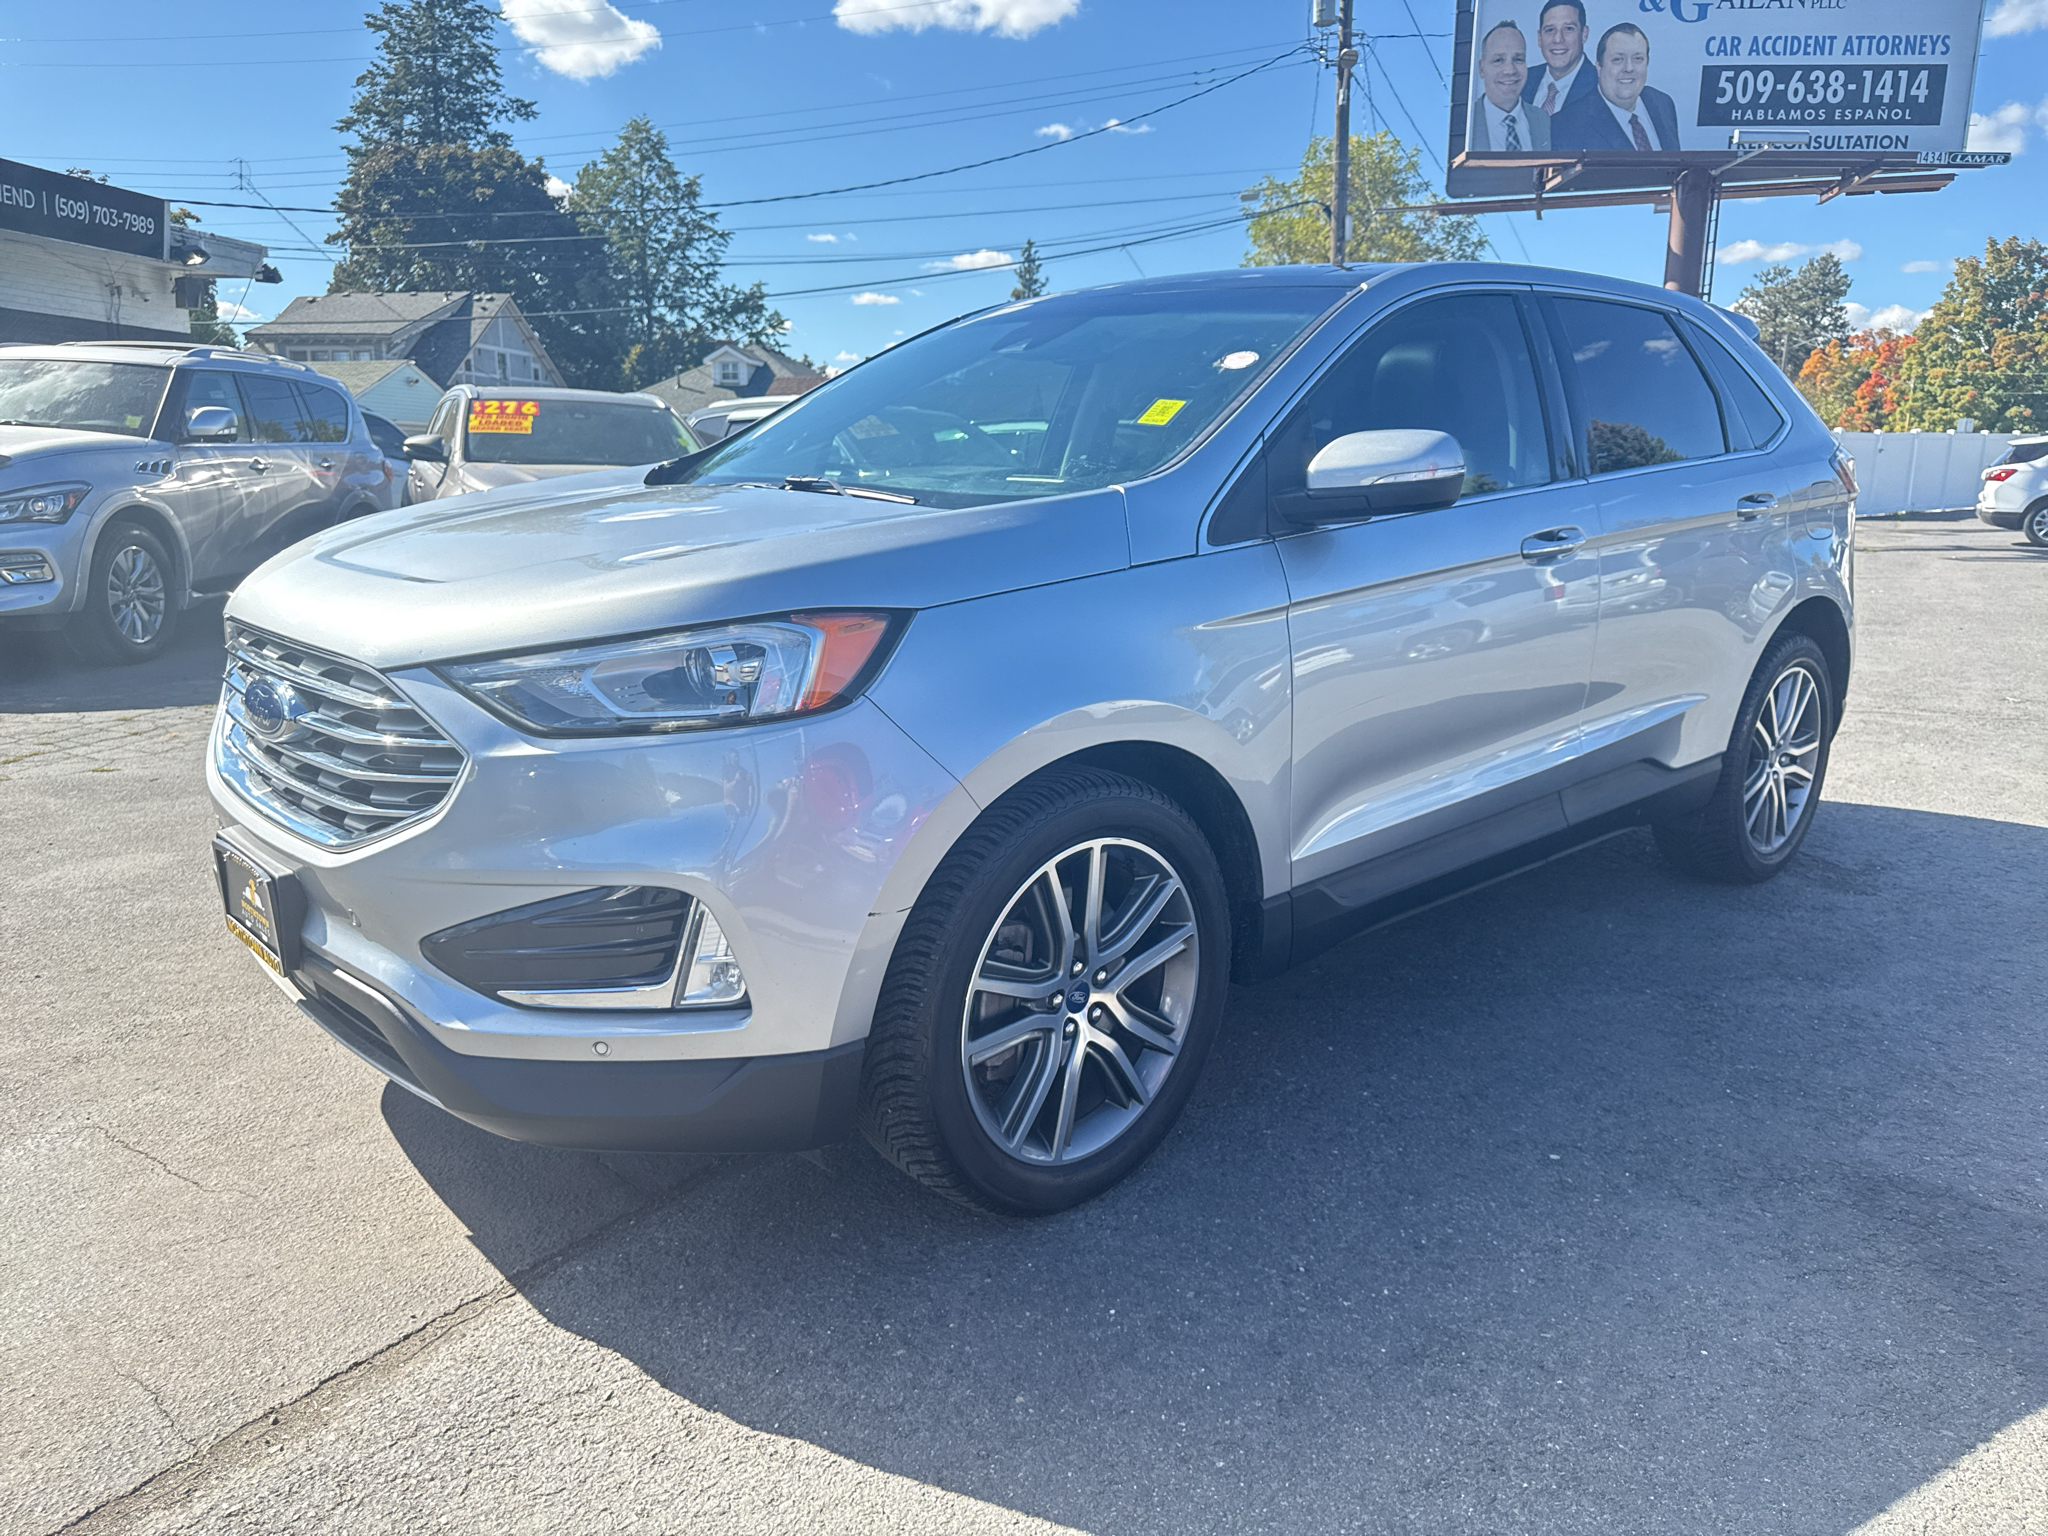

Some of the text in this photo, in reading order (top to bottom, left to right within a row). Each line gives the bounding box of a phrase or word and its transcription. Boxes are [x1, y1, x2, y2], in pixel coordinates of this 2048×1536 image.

[1705, 34, 1951, 57] CAR ACCIDENT ATTORNEYS
[1715, 69, 1930, 105] 509-638-1414
[1731, 106, 1912, 121] HABLAMOS ESPAÑOL
[1955, 154, 2006, 164] LAMAR
[55, 194, 90, 225] (509)
[93, 205, 155, 236] 703-7989
[473, 400, 538, 415] $276
